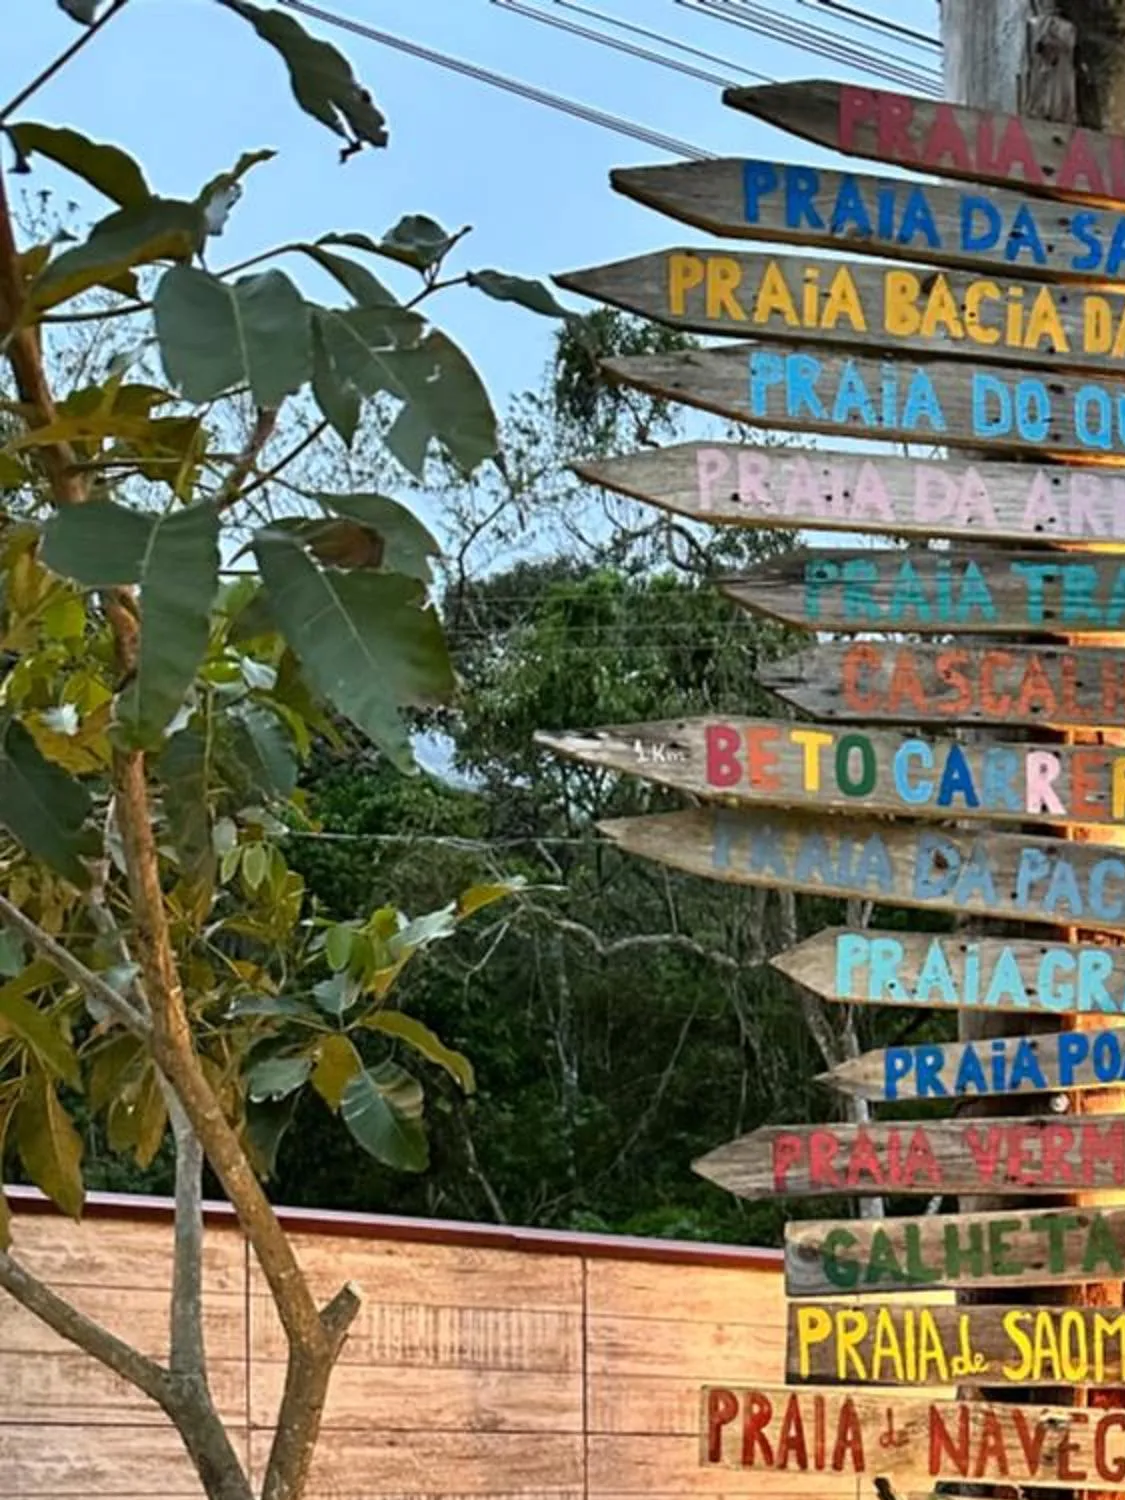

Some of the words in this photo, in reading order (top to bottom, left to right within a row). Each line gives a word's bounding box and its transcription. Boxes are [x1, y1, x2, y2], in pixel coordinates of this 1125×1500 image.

[839, 86, 1043, 183] PRAIA
[959, 195, 1046, 264] DA
[971, 371, 1049, 442] DO
[912, 464, 1000, 527] DA
[634, 738, 650, 763] 1
[704, 723, 877, 798] BETO
[912, 833, 1000, 906] DA
[772, 1124, 943, 1192] PRAIA
[796, 1307, 948, 1382] PRAIA
[950, 1315, 989, 1375] de
[707, 1388, 865, 1473] PRAIA
